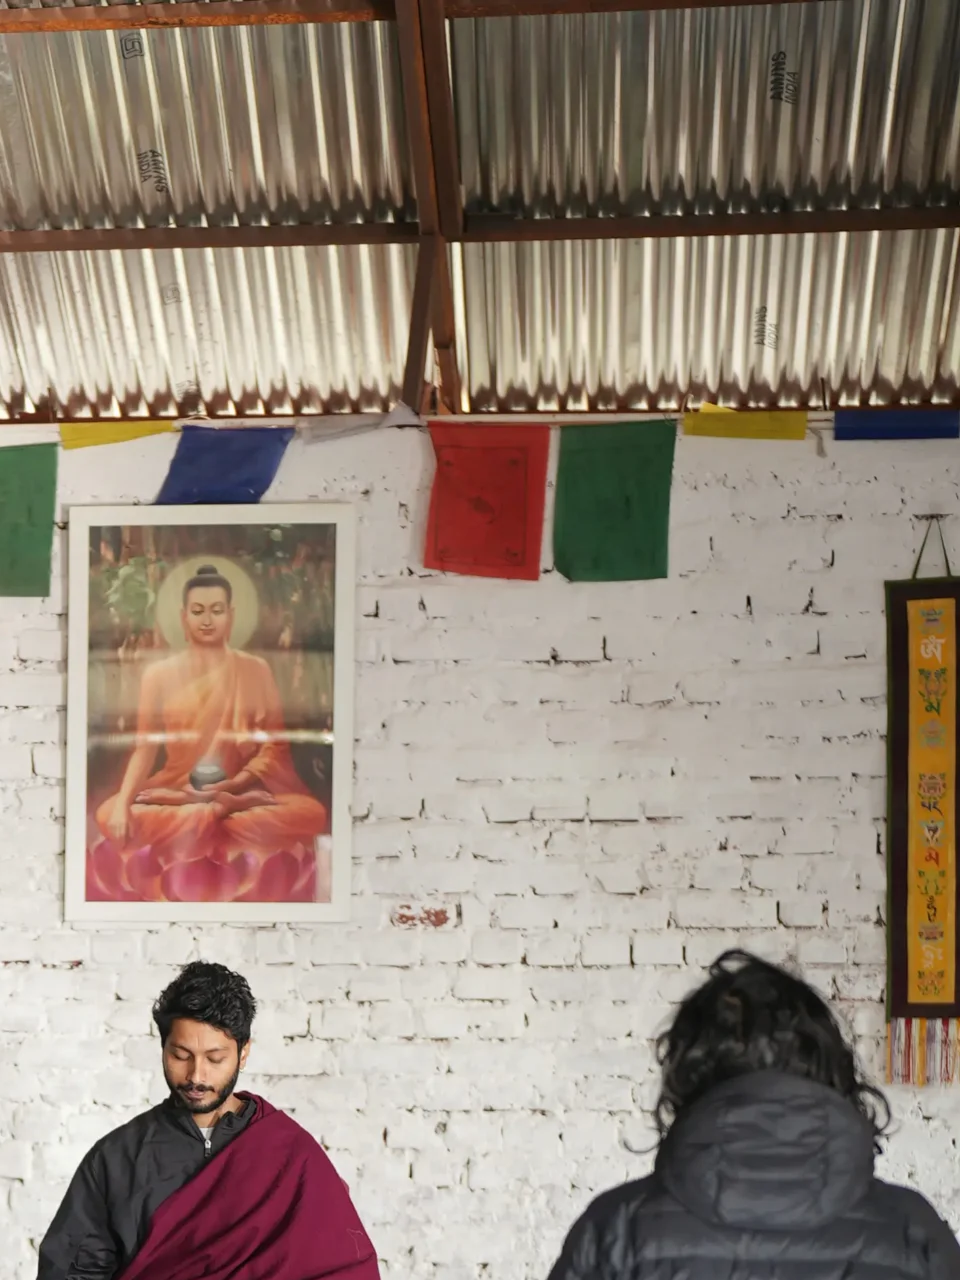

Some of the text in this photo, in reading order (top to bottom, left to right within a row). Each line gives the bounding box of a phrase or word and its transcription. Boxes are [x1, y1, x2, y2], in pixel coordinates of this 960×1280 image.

[770, 51, 786, 101] AMINS
[784, 71, 798, 104] INDIA
[137, 151, 152, 184] INDIA
[149, 149, 168, 192] AMINS
